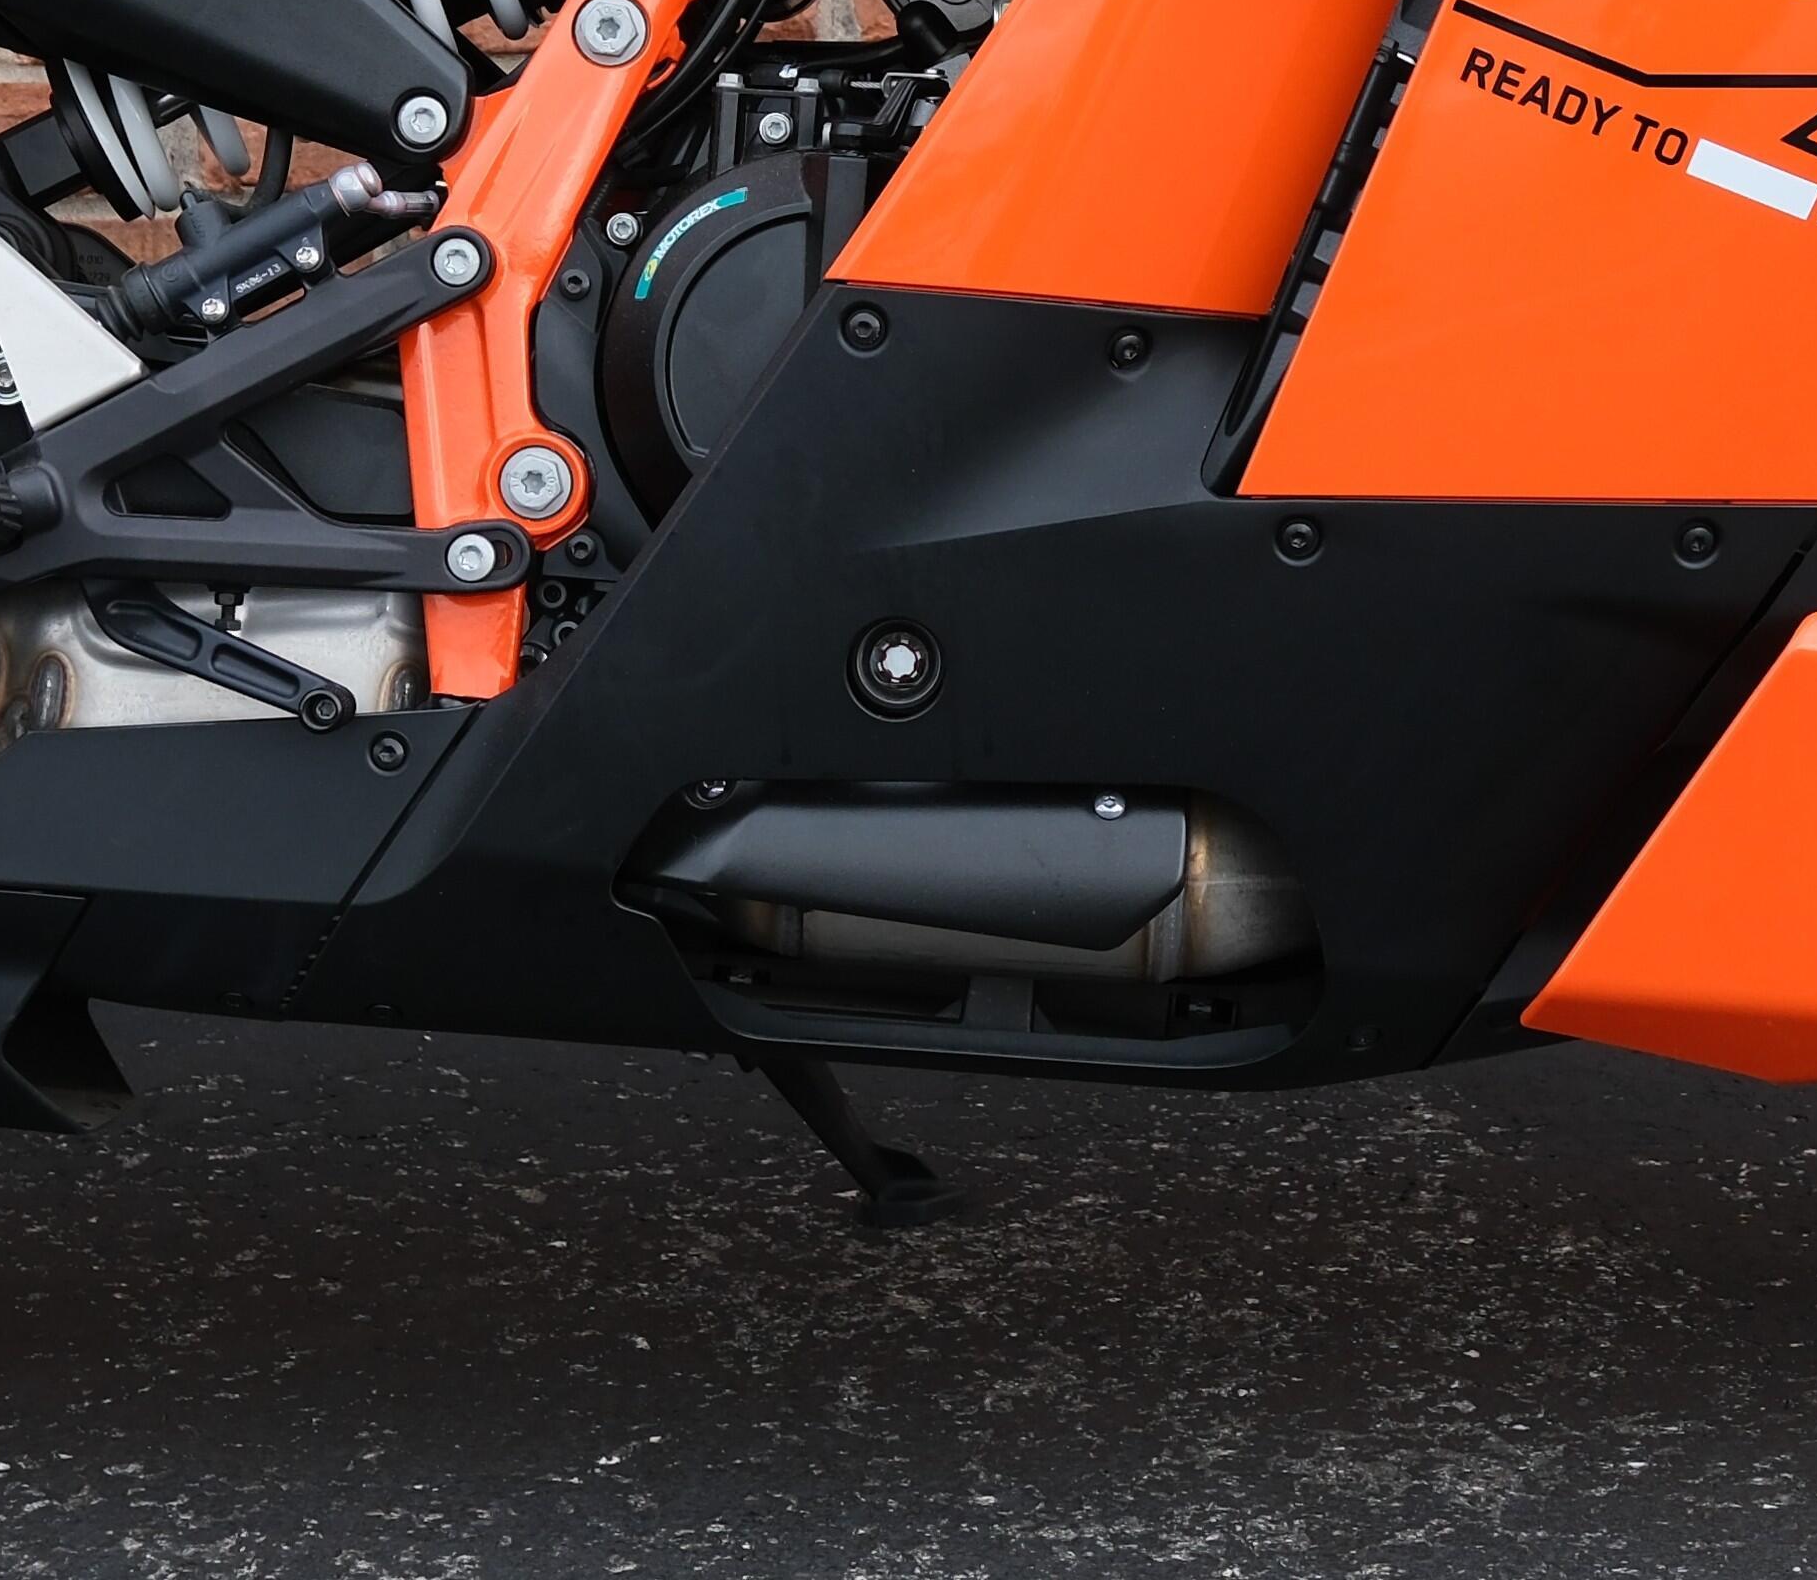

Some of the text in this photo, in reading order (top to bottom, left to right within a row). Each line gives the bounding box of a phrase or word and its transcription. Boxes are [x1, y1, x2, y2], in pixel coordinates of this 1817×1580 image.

[1459, 46, 1623, 137] READY
[1630, 113, 1690, 167] TO
[652, 198, 719, 260] MOTOREX
